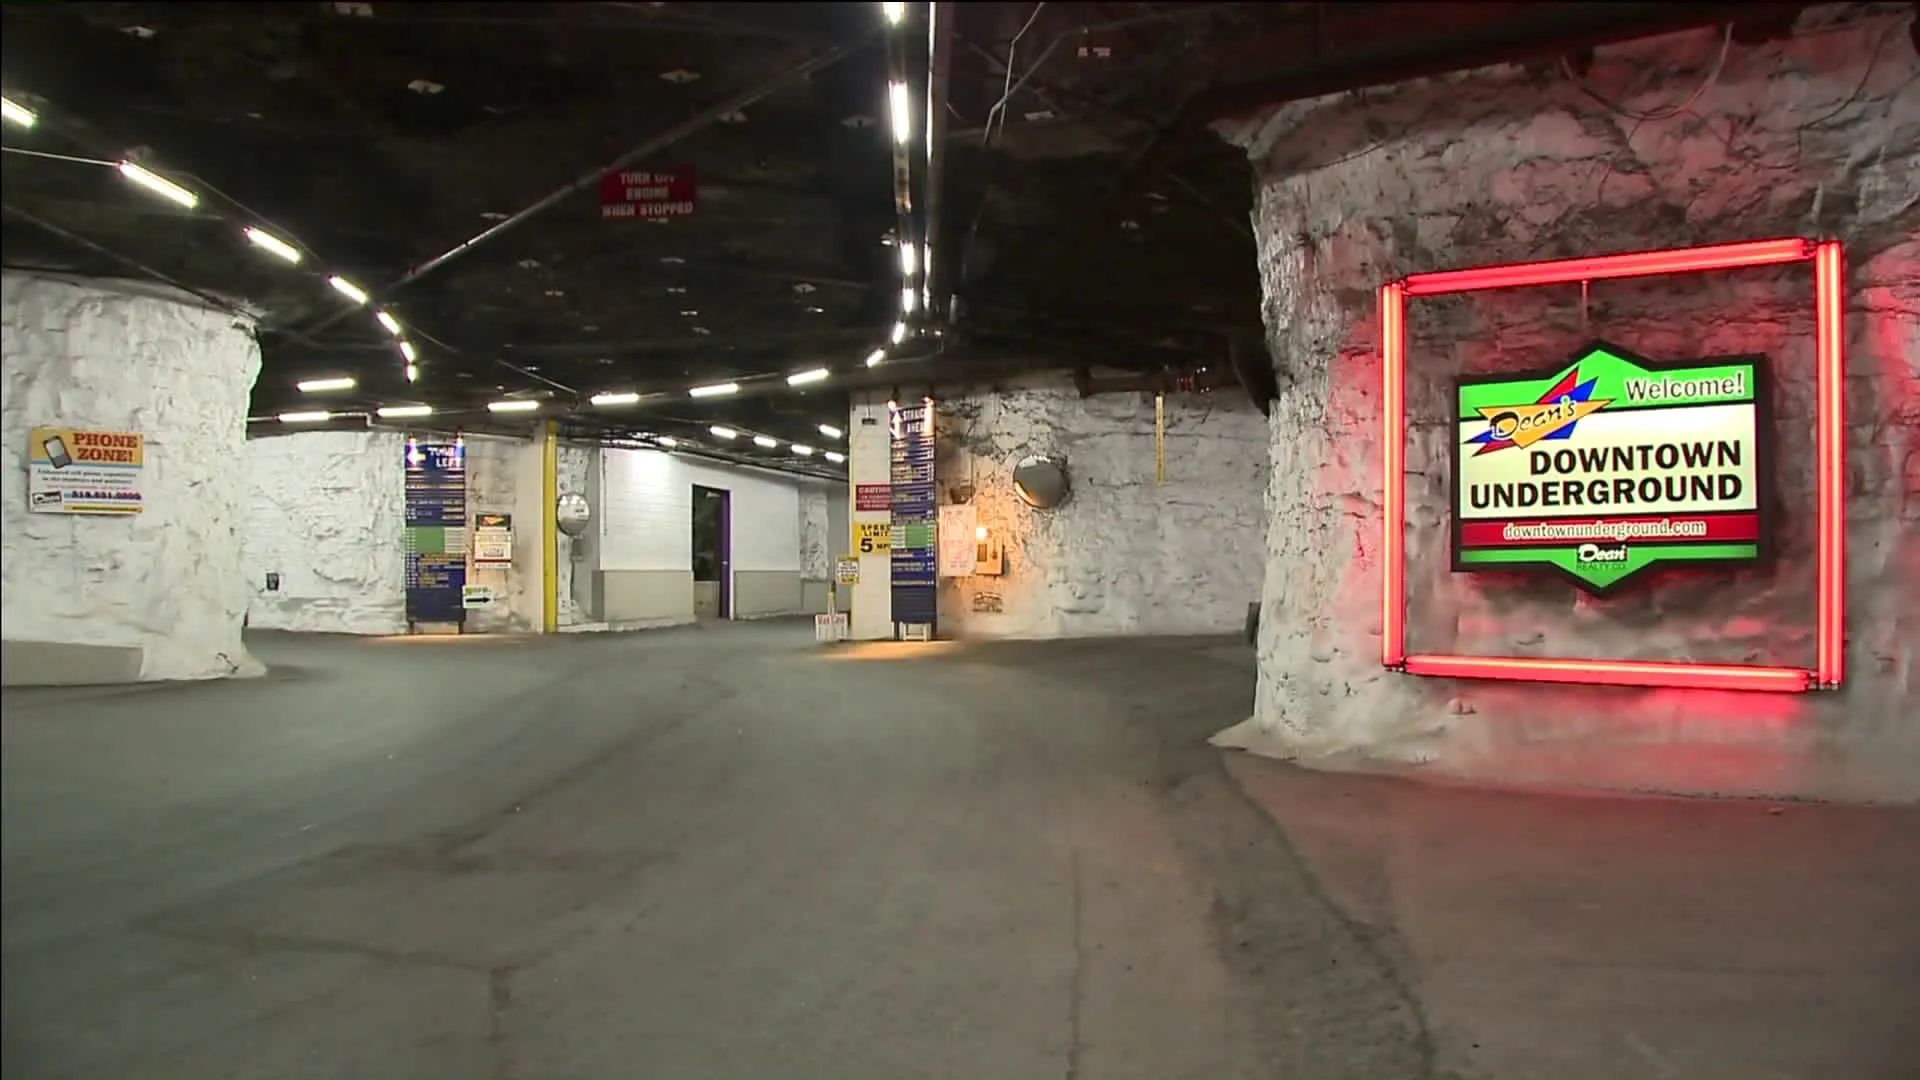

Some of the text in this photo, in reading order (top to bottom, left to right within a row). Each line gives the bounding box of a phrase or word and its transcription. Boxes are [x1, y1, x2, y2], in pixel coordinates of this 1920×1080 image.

[626, 186, 669, 200] ENGINE
[602, 200, 694, 217] WHEN STOPPED
[1626, 372, 1744, 400] Welcome!
[1489, 396, 1576, 439] Dean's
[73, 432, 138, 448] PHONE
[77, 448, 133, 462] ZONE!
[1529, 440, 1742, 476] DOWNTOWN
[1470, 474, 1743, 509] UNDERGROUND
[1504, 519, 1706, 540] downtownunderground.com
[860, 538, 873, 552] 5
